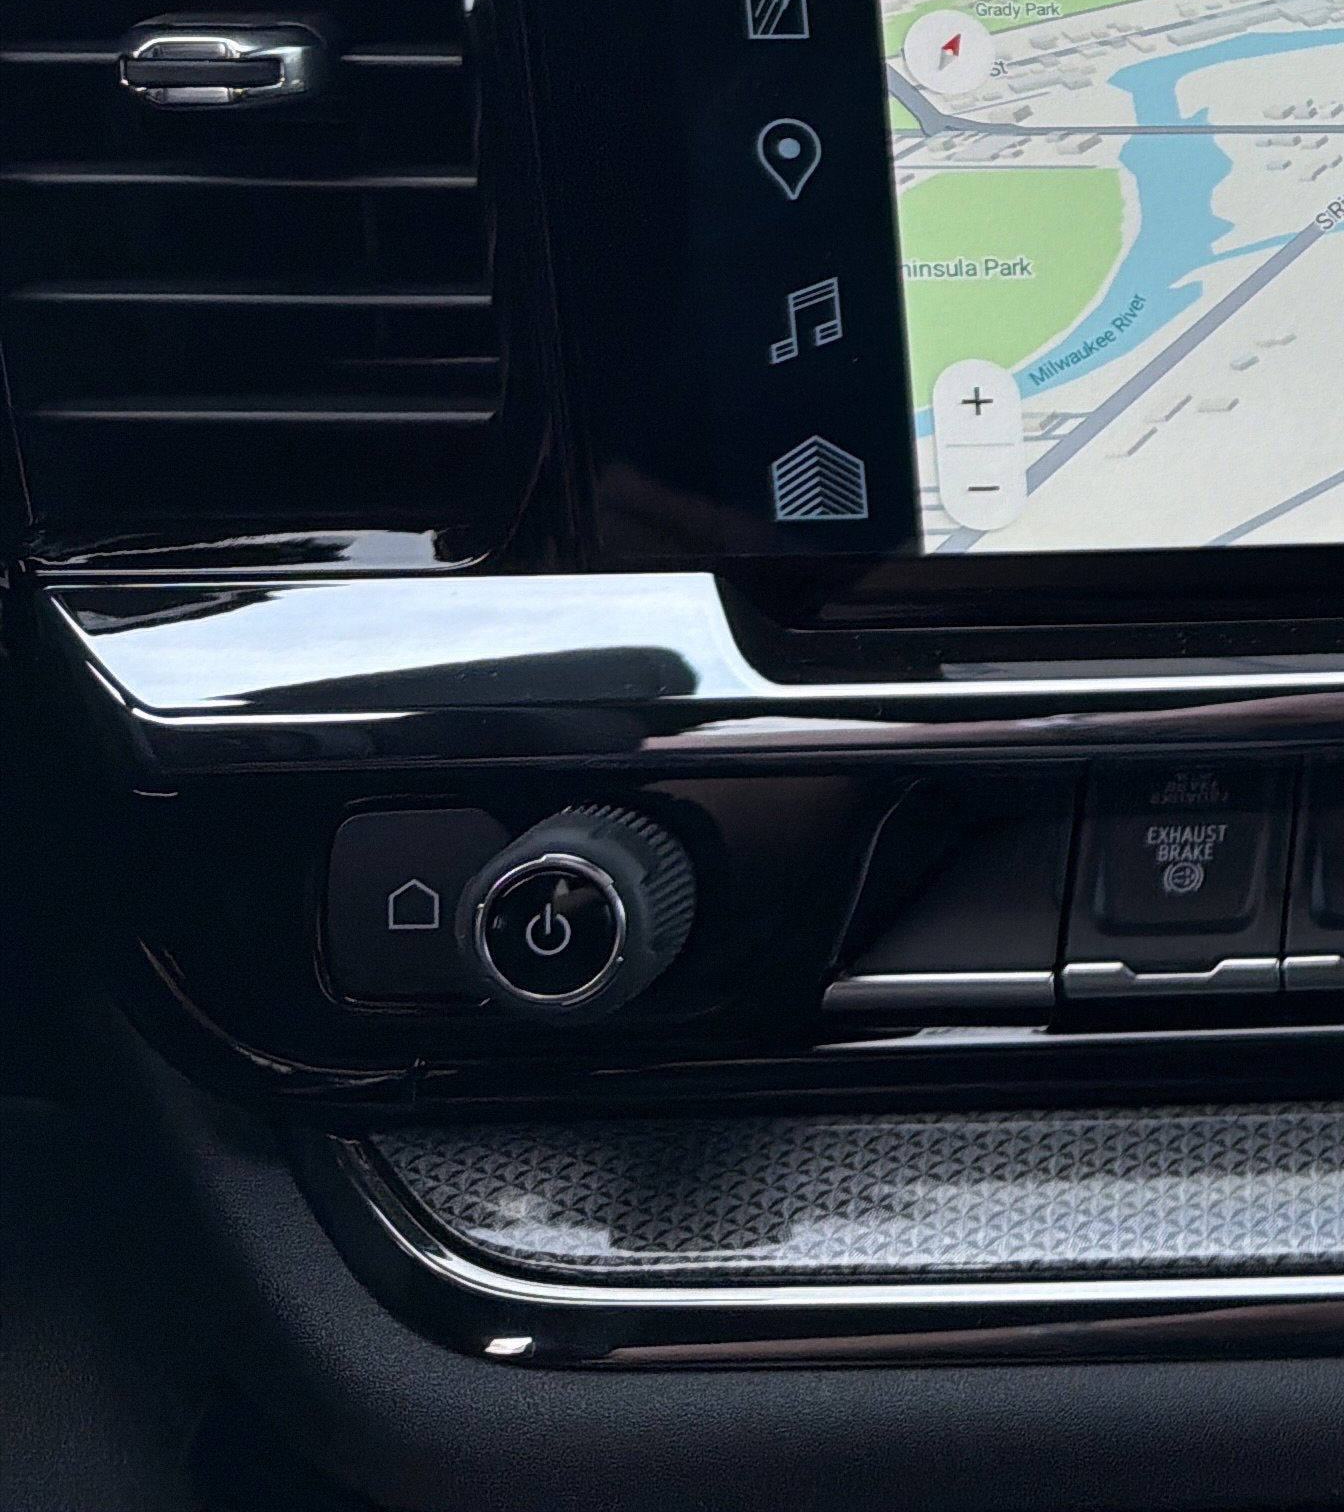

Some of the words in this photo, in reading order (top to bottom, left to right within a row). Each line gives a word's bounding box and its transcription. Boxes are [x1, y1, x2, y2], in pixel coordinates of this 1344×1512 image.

[975, 3, 1020, 18] Grady
[1026, 3, 1060, 16] Park
[1315, 213, 1332, 231] S
[902, 259, 978, 278] ninsula
[984, 258, 1033, 276] Park
[1029, 331, 1116, 385] Milwaukee
[1112, 294, 1147, 333] River
[1147, 824, 1228, 844] EXHAUST
[1158, 843, 1214, 862] BRAKE
